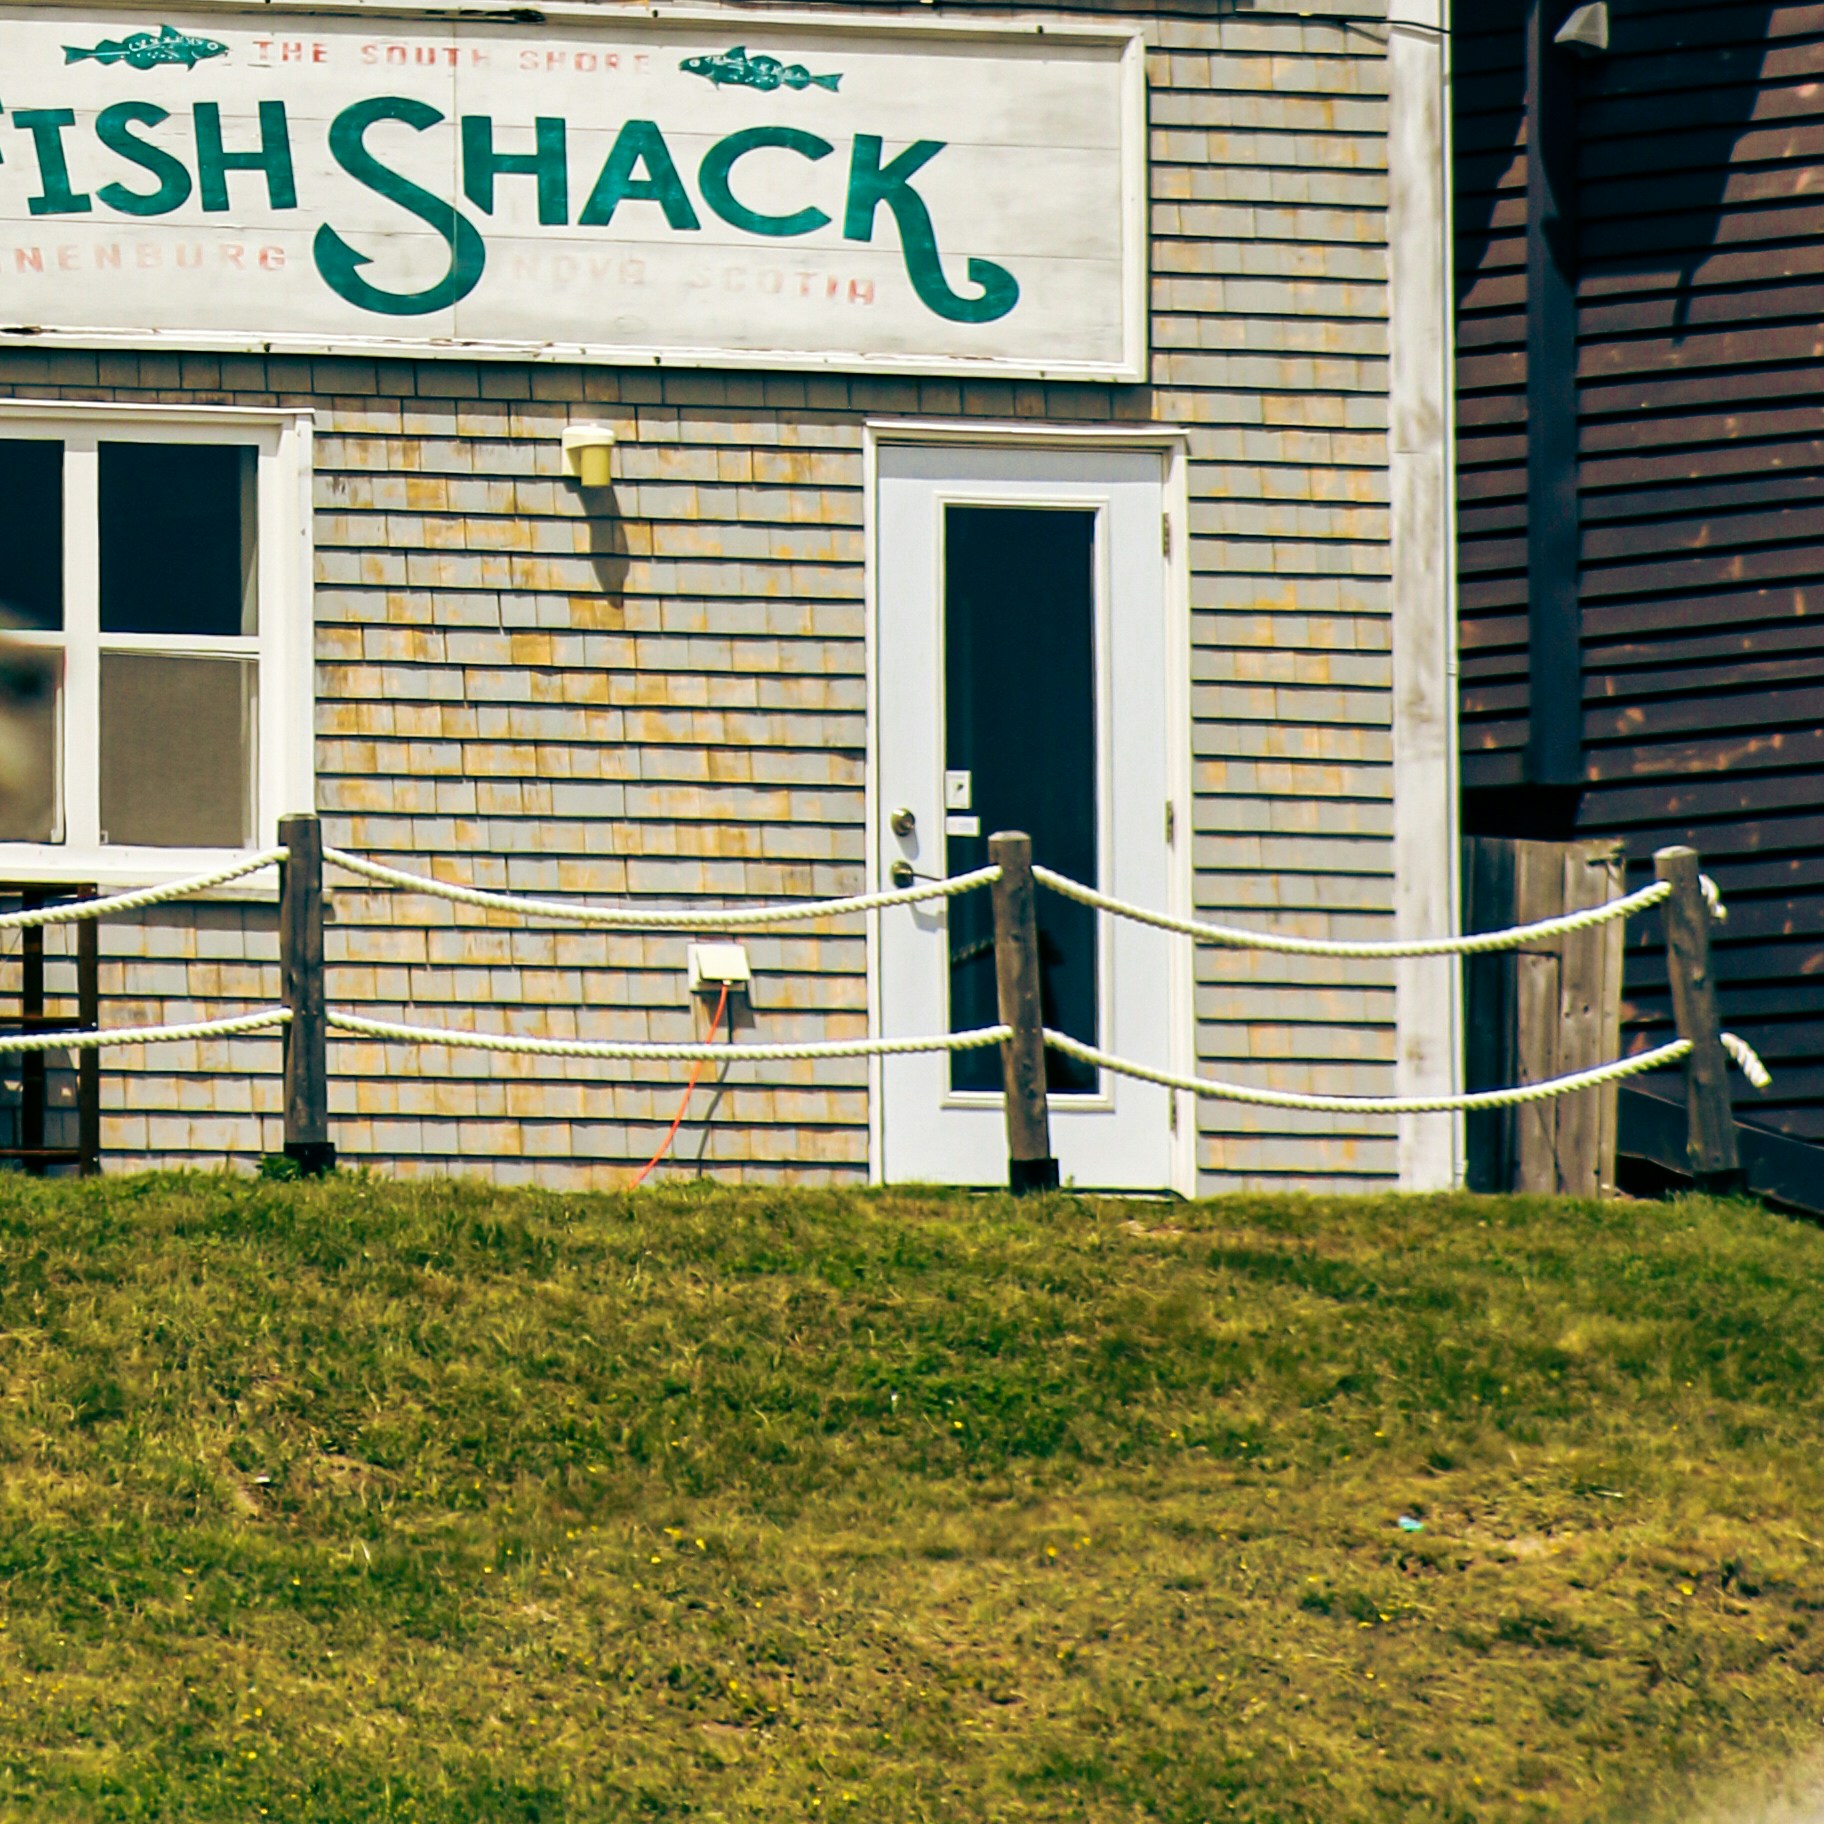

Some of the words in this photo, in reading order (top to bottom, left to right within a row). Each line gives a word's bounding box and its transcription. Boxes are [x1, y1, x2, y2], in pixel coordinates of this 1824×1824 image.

[252, 39, 329, 64] THE
[360, 44, 494, 69] SOUTH
[519, 49, 651, 75] SHORE
[313, 95, 1021, 324] SHACK
[510, 255, 647, 286] NOVA
[687, 264, 876, 306] SCOTIA
